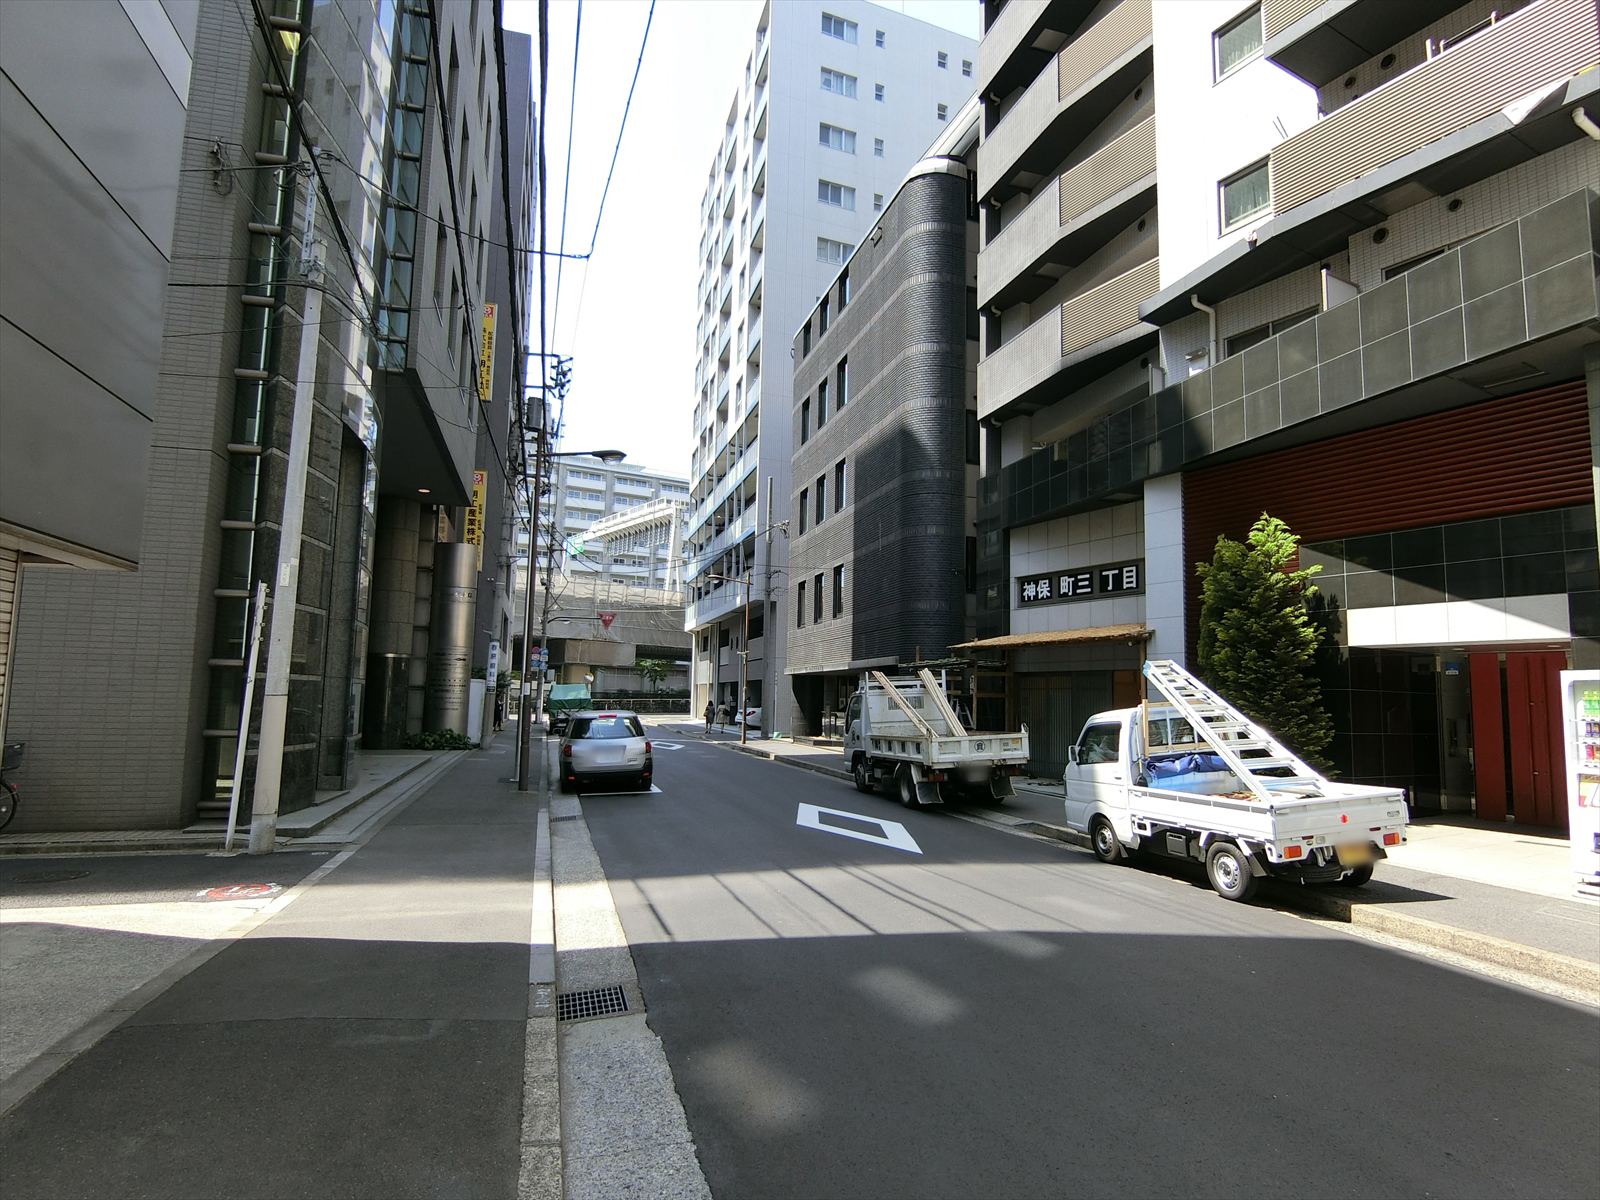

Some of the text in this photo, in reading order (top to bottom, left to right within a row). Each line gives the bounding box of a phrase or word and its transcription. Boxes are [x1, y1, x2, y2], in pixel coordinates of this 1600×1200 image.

[1023, 566, 1137, 601] 神保町三丁目
